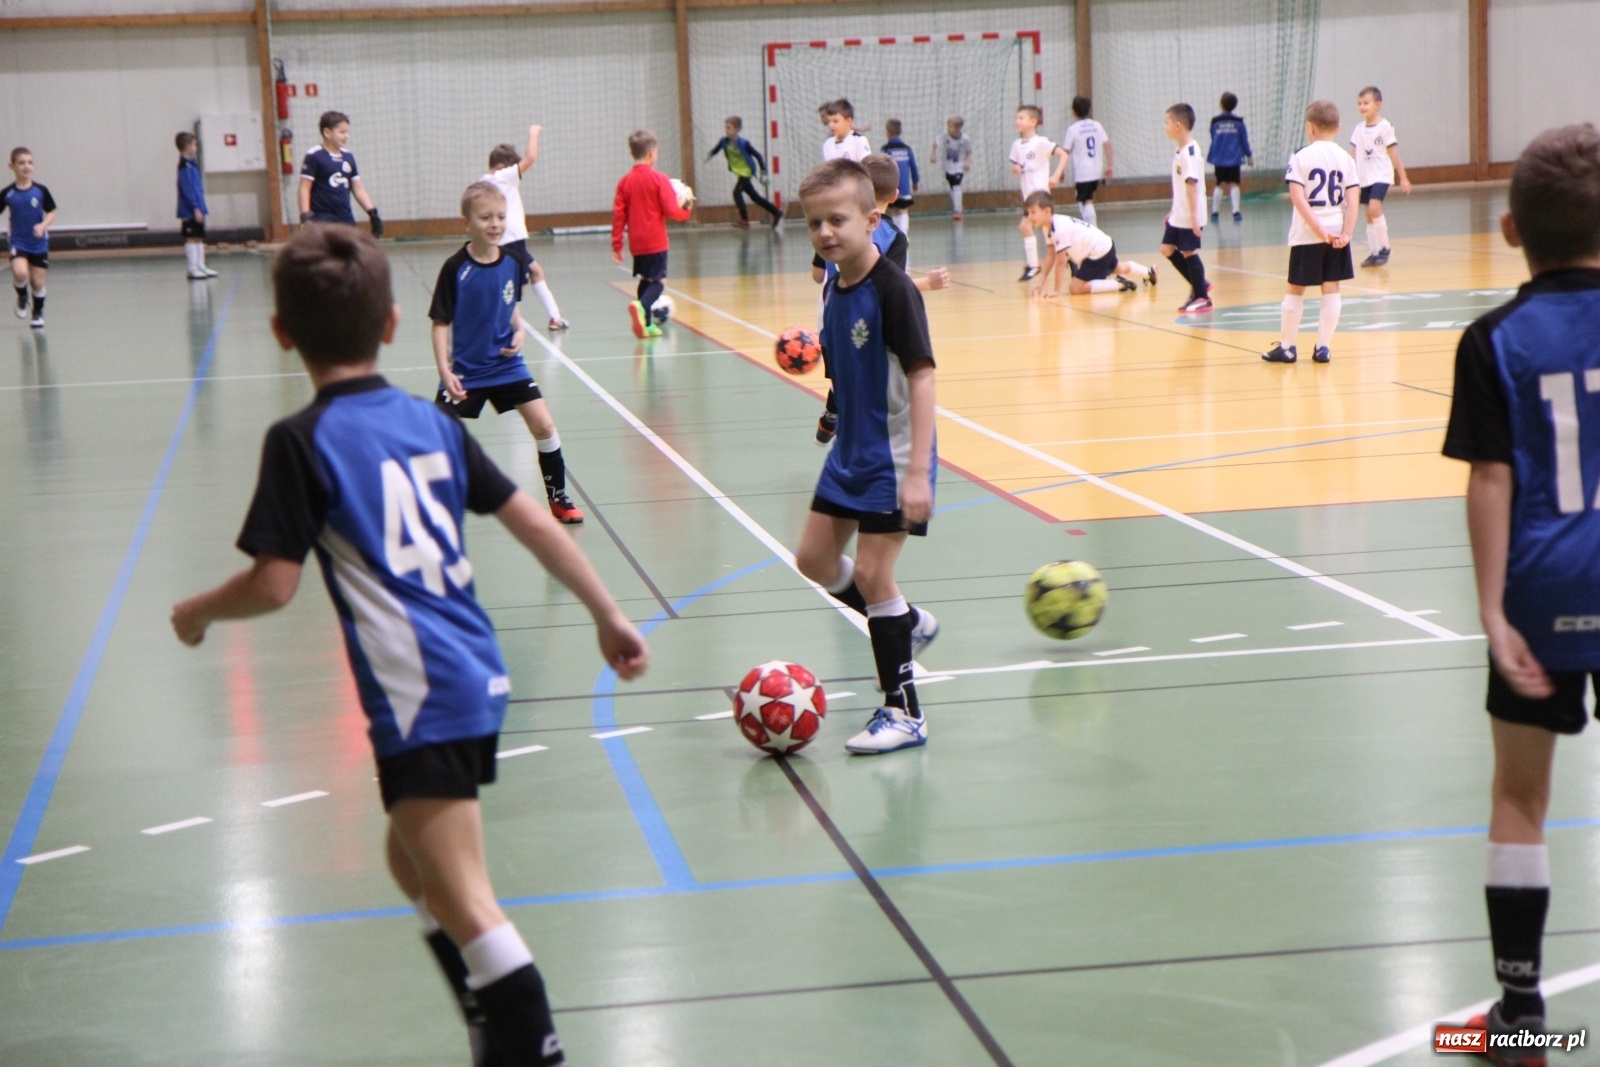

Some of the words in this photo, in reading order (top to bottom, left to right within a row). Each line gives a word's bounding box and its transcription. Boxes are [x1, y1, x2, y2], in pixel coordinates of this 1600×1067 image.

[1086, 136, 1095, 158] 9
[1308, 168, 1343, 207] 26
[381, 451, 473, 597] 45
